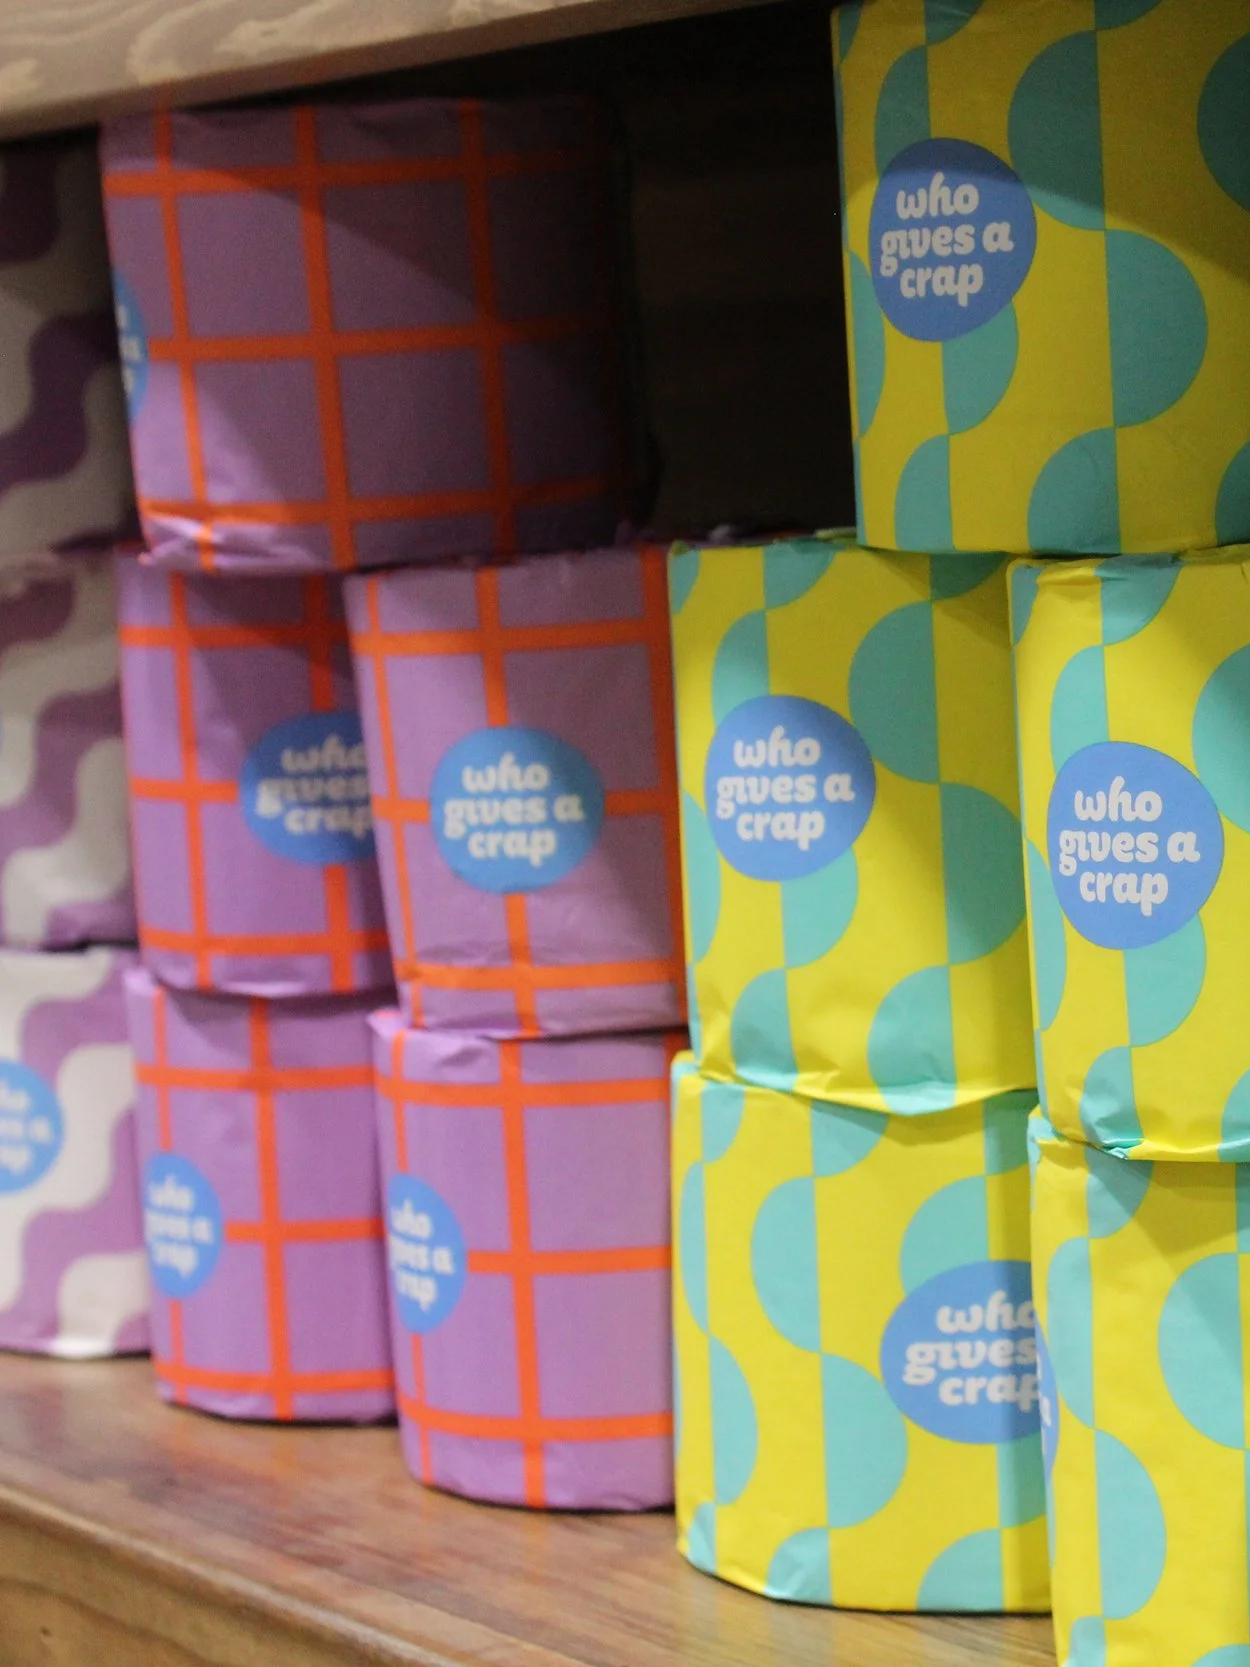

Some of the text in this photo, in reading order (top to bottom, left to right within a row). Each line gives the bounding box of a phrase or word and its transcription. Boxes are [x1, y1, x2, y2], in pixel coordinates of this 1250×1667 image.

[895, 171, 979, 220] who
[879, 221, 1015, 277] gives a
[900, 263, 984, 307] crap
[733, 725, 821, 768] who
[462, 751, 549, 793] who
[443, 794, 585, 839] gives a
[716, 773, 856, 820] gives a
[1074, 776, 1163, 822] who
[468, 828, 557, 867] crap
[736, 811, 826, 851] crap
[1058, 830, 1201, 876] gives a
[1079, 871, 1169, 917] crap
